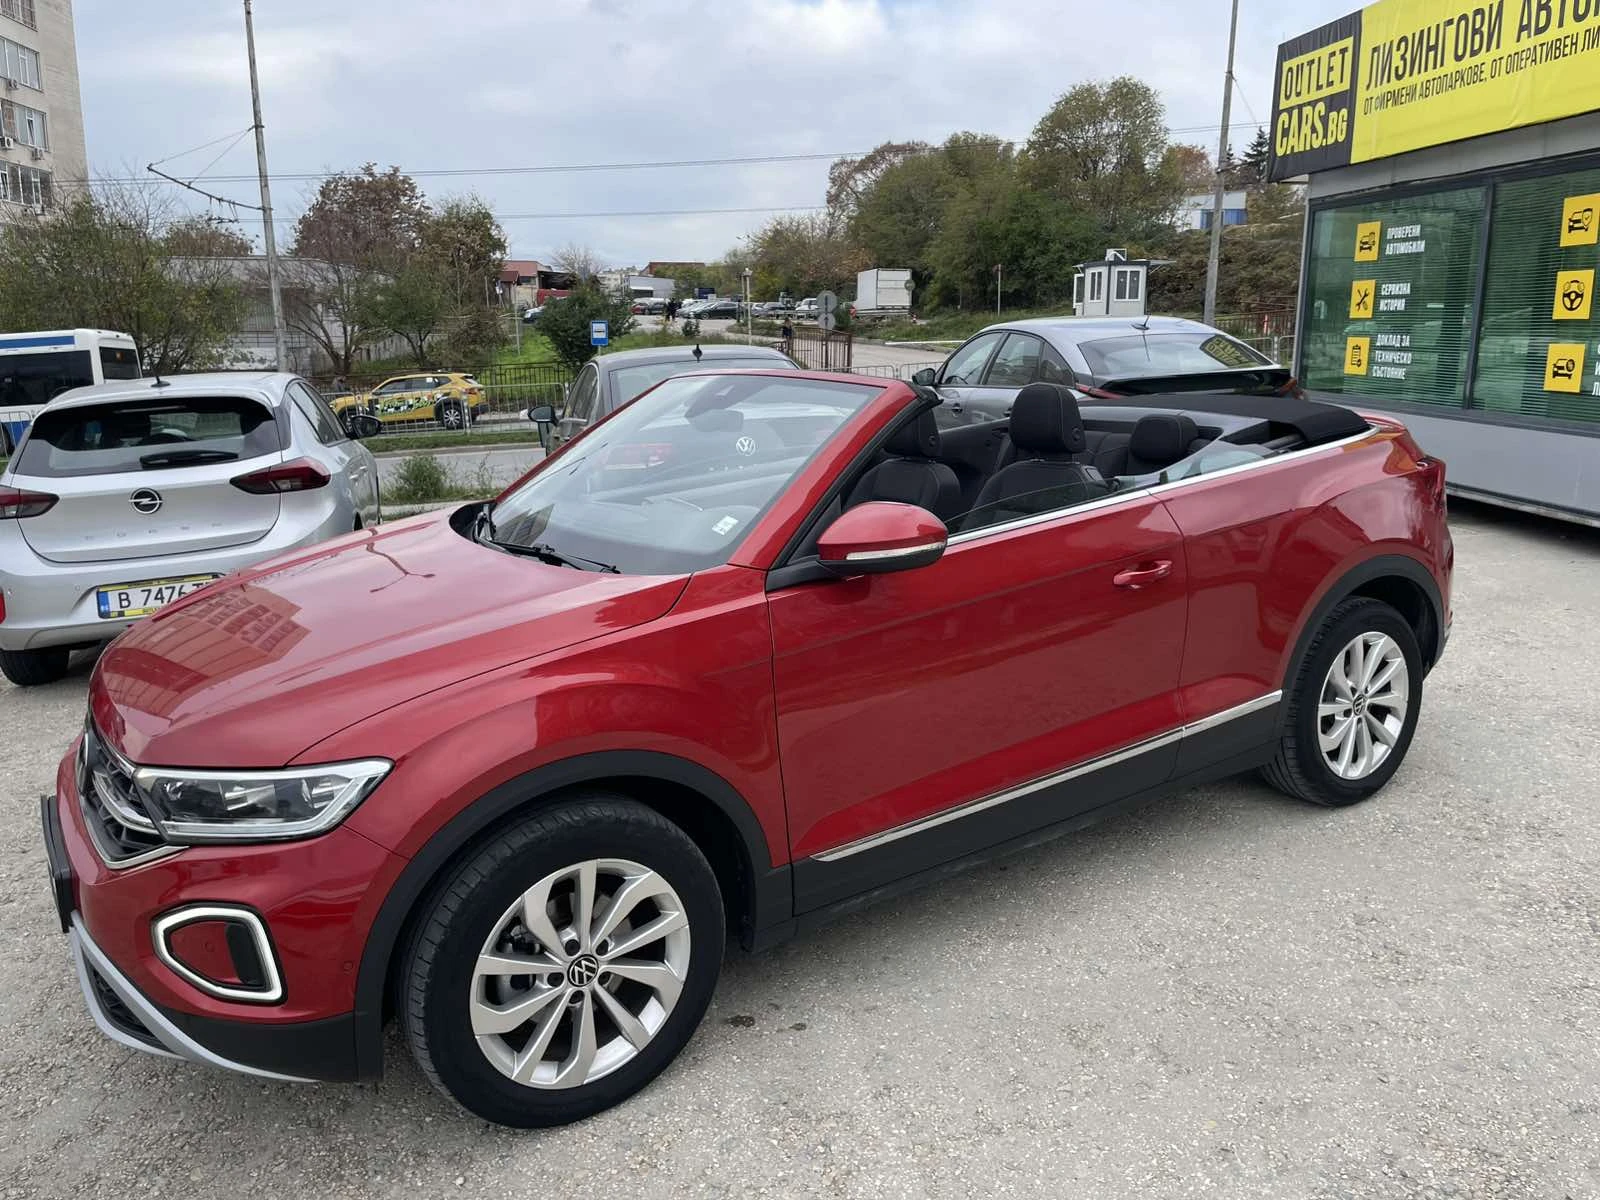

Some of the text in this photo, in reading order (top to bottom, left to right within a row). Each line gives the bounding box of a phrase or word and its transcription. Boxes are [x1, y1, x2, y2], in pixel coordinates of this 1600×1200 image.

[1284, 46, 1349, 101] OUTLET
[1364, 96, 1374, 115] ОТ
[1375, 83, 1418, 111] ФИРМЕНИ
[1419, 62, 1487, 98] АВТОПАРКОВЕ,
[1490, 56, 1504, 80] ОТ
[1505, 32, 1579, 75] ОПЕРАТИВЕН
[1366, 0, 1504, 91] ЛИЗИНГОВИ
[1275, 101, 1349, 157] CARS.BG
[1385, 240, 1426, 255] АВТОМОБИЛИ
